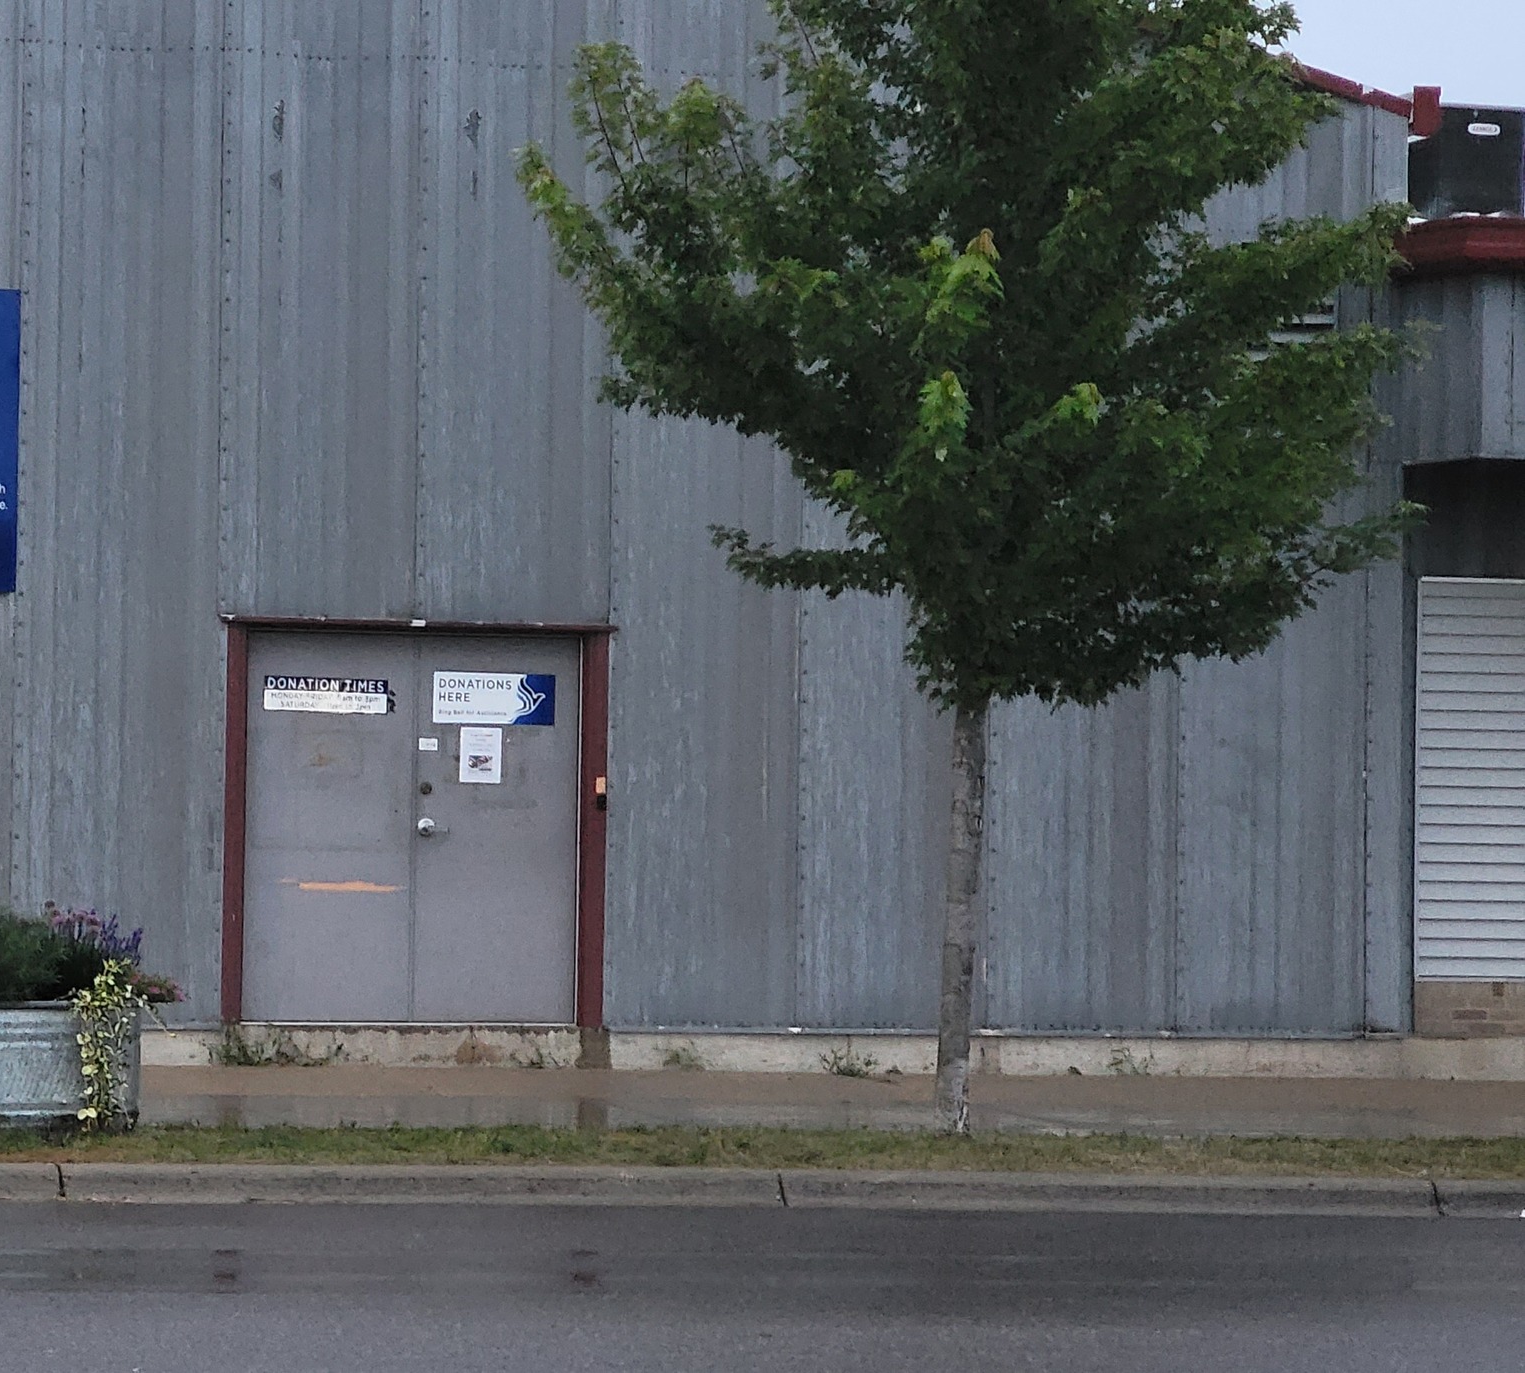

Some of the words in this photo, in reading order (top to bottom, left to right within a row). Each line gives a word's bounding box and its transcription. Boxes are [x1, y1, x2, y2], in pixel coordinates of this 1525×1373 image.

[267, 677, 340, 691] DONATION
[344, 679, 384, 692] TIMES
[439, 678, 512, 690] DONATIONS
[439, 692, 470, 702] HERE
